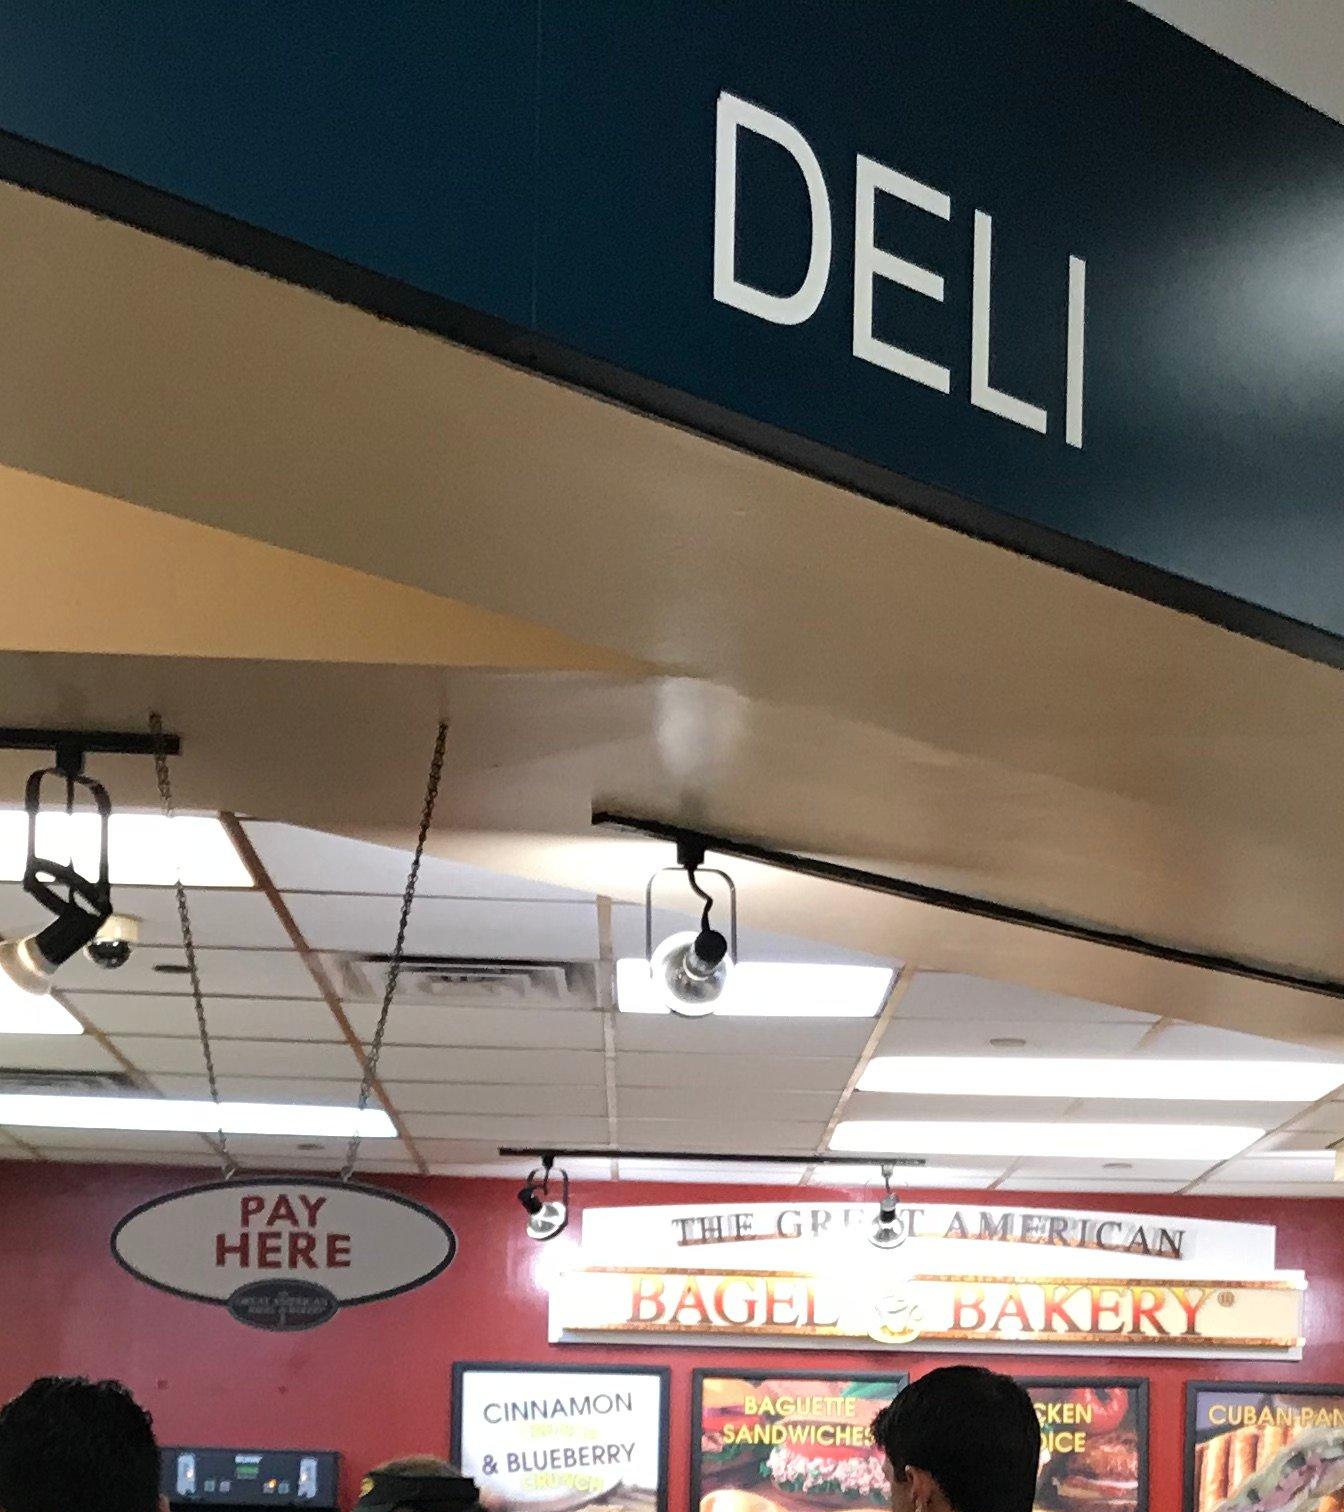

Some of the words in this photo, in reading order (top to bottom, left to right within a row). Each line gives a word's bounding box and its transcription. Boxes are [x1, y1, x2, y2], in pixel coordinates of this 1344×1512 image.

[714, 90, 1086, 449] DELI
[240, 1193, 327, 1228] PAY
[672, 1213, 754, 1244] THE
[776, 1209, 925, 1239] GRT
[944, 1210, 1185, 1258] AMERICAN
[216, 1232, 352, 1268] HERE
[626, 1273, 840, 1328] BAGEL
[483, 1393, 633, 1424] CINNAMON
[744, 1396, 856, 1417] BAGUETTE
[1034, 1402, 1092, 1424] CKEN
[1208, 1404, 1292, 1426] CUBAN
[723, 1424, 875, 1446] SANDWICHES
[1040, 1431, 1086, 1453] ICE
[482, 1454, 499, 1475] &
[507, 1443, 635, 1473] BLUEBERRY
